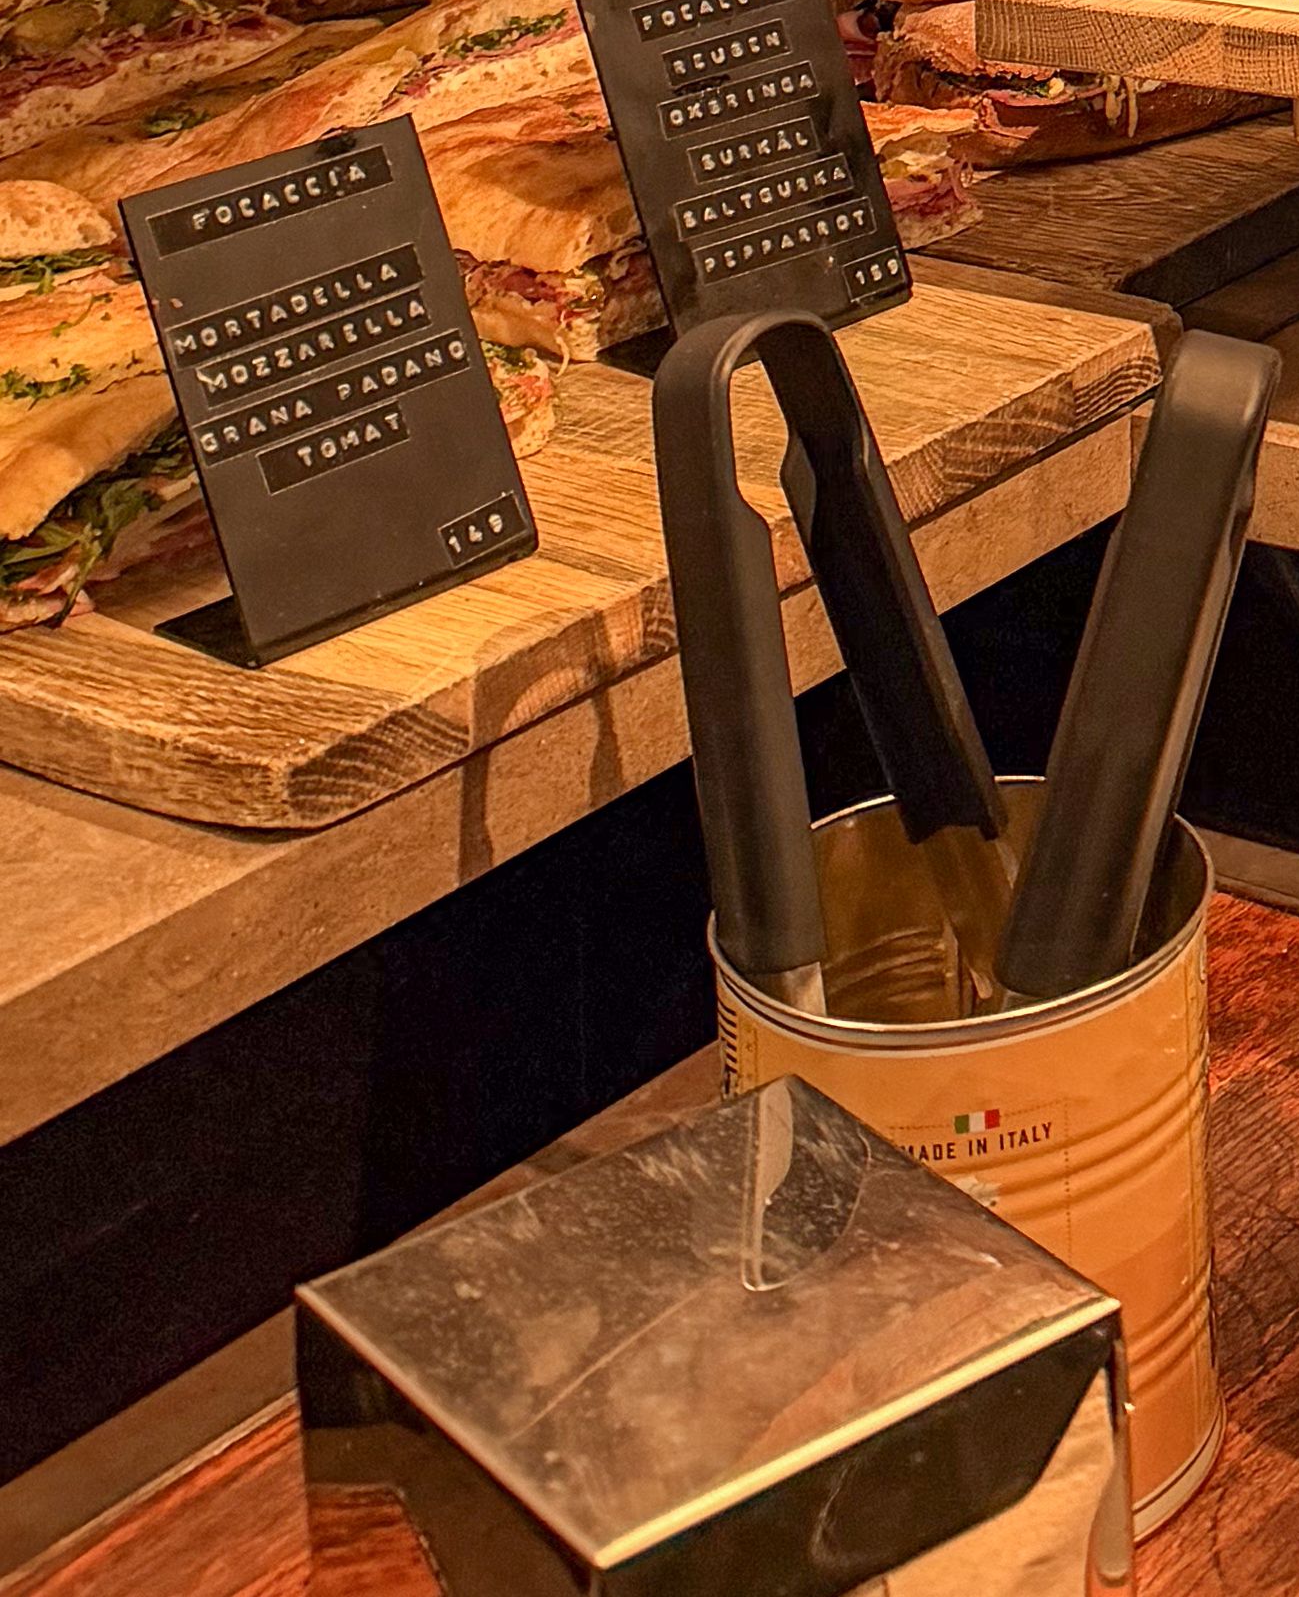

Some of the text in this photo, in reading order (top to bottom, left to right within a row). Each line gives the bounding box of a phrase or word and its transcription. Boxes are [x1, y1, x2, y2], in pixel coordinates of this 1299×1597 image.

[672, 31, 782, 76] REUBEN
[669, 73, 814, 127] OXBRINGA
[700, 129, 808, 172] SURKÅL
[191, 163, 368, 232] FOCACCIA
[682, 166, 847, 229] SALTGURKA
[704, 208, 865, 274] PEPPARROT
[173, 262, 399, 355] MORTADELLA
[201, 299, 426, 394] MOZZARELLA
[200, 339, 466, 455] GRANA PADANO
[297, 411, 400, 467] TOMAT
[448, 513, 503, 553] 149
[968, 1137, 988, 1157] IN
[999, 1122, 1053, 1151] ITALY
